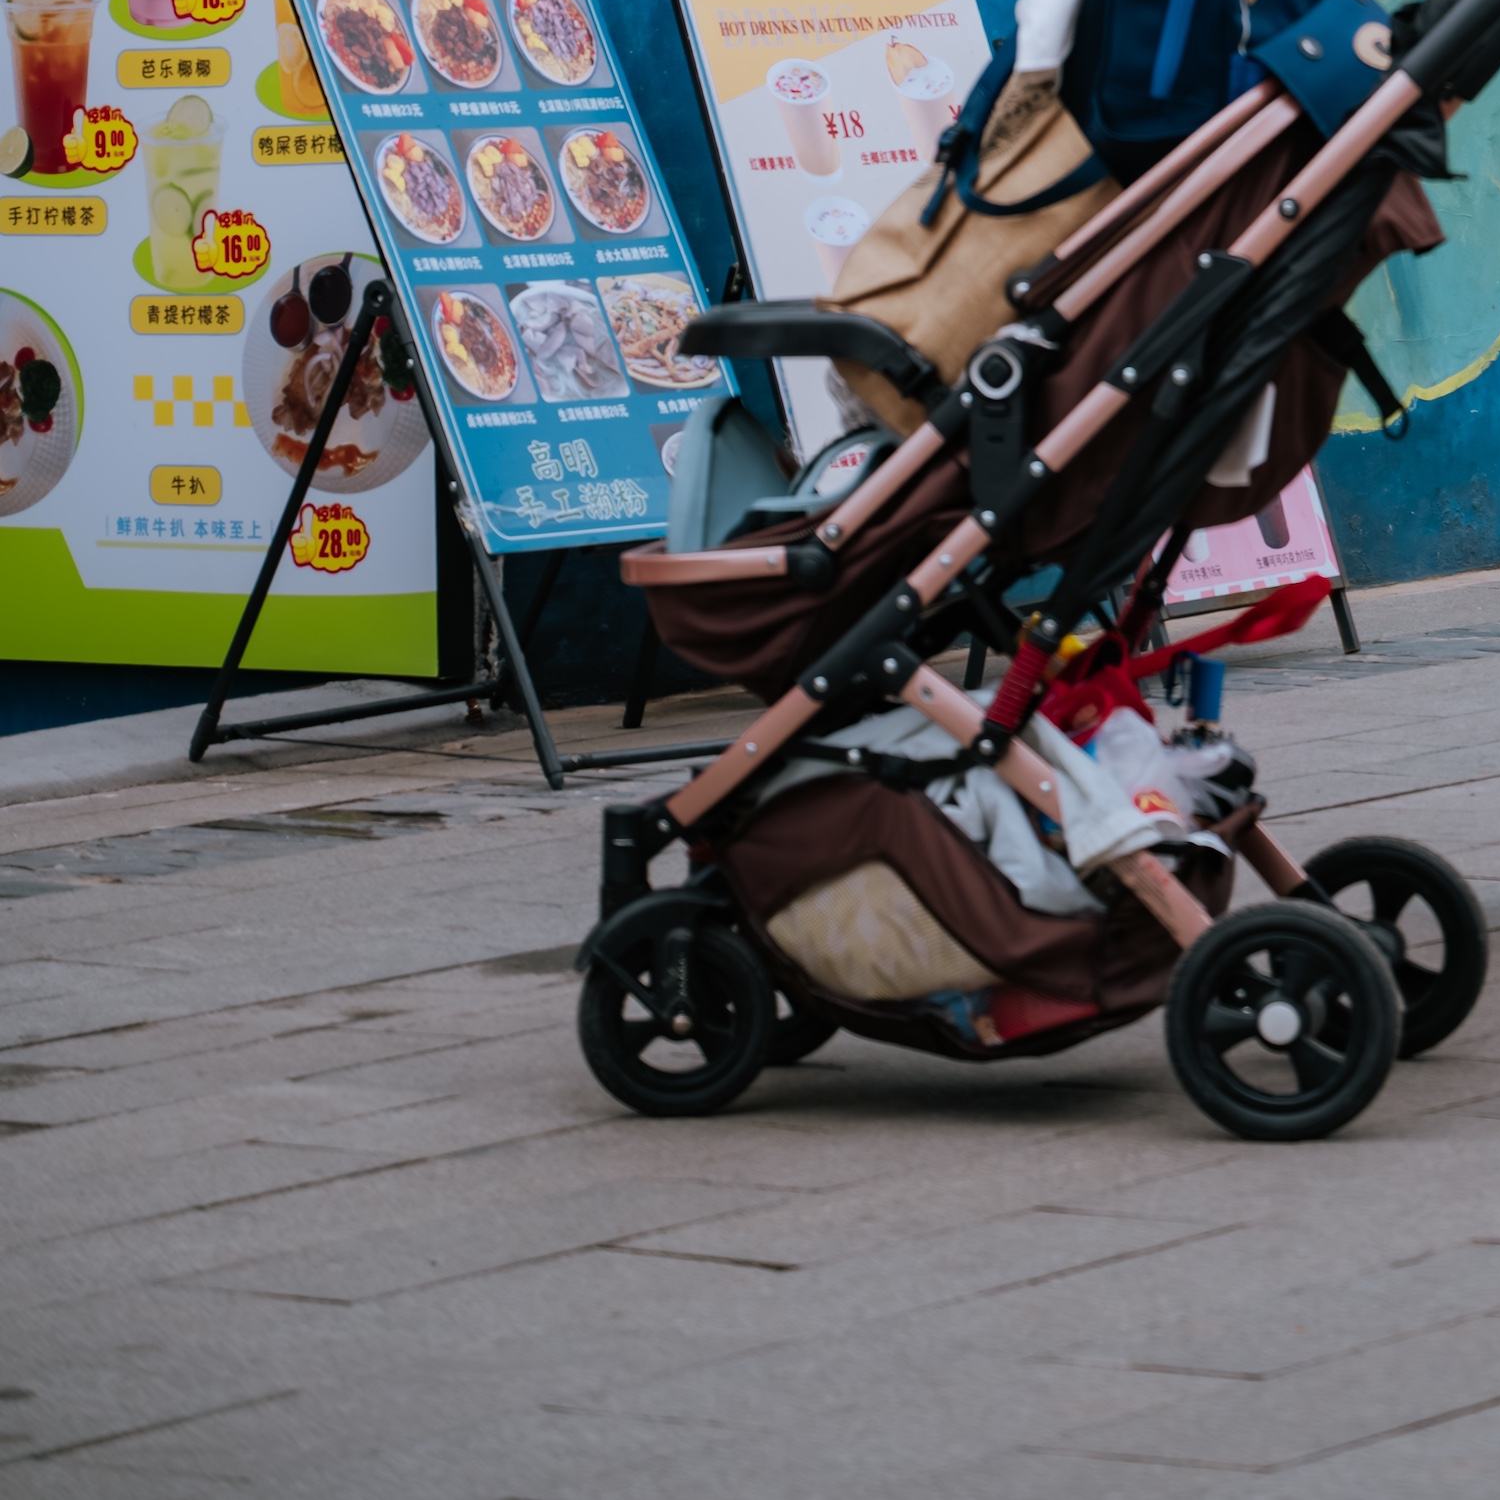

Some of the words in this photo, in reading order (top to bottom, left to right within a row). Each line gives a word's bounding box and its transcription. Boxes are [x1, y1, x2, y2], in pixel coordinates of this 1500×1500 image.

[719, 21, 748, 38] HOT
[751, 19, 799, 35] DRINKS
[801, 19, 816, 34] IN
[819, 16, 874, 33] AUTUMN
[877, 15, 903, 31] AND
[904, 12, 959, 29] WINTER
[823, 110, 866, 140] ¥18
[8, 206, 95, 226] 手打柠檬茶
[147, 305, 230, 325] 青提柠檬茶
[528, 438, 598, 482] 高明
[171, 475, 206, 495] 牛扒
[116, 515, 185, 539] 鲜煎牛扒
[194, 518, 263, 540] 本味至上
